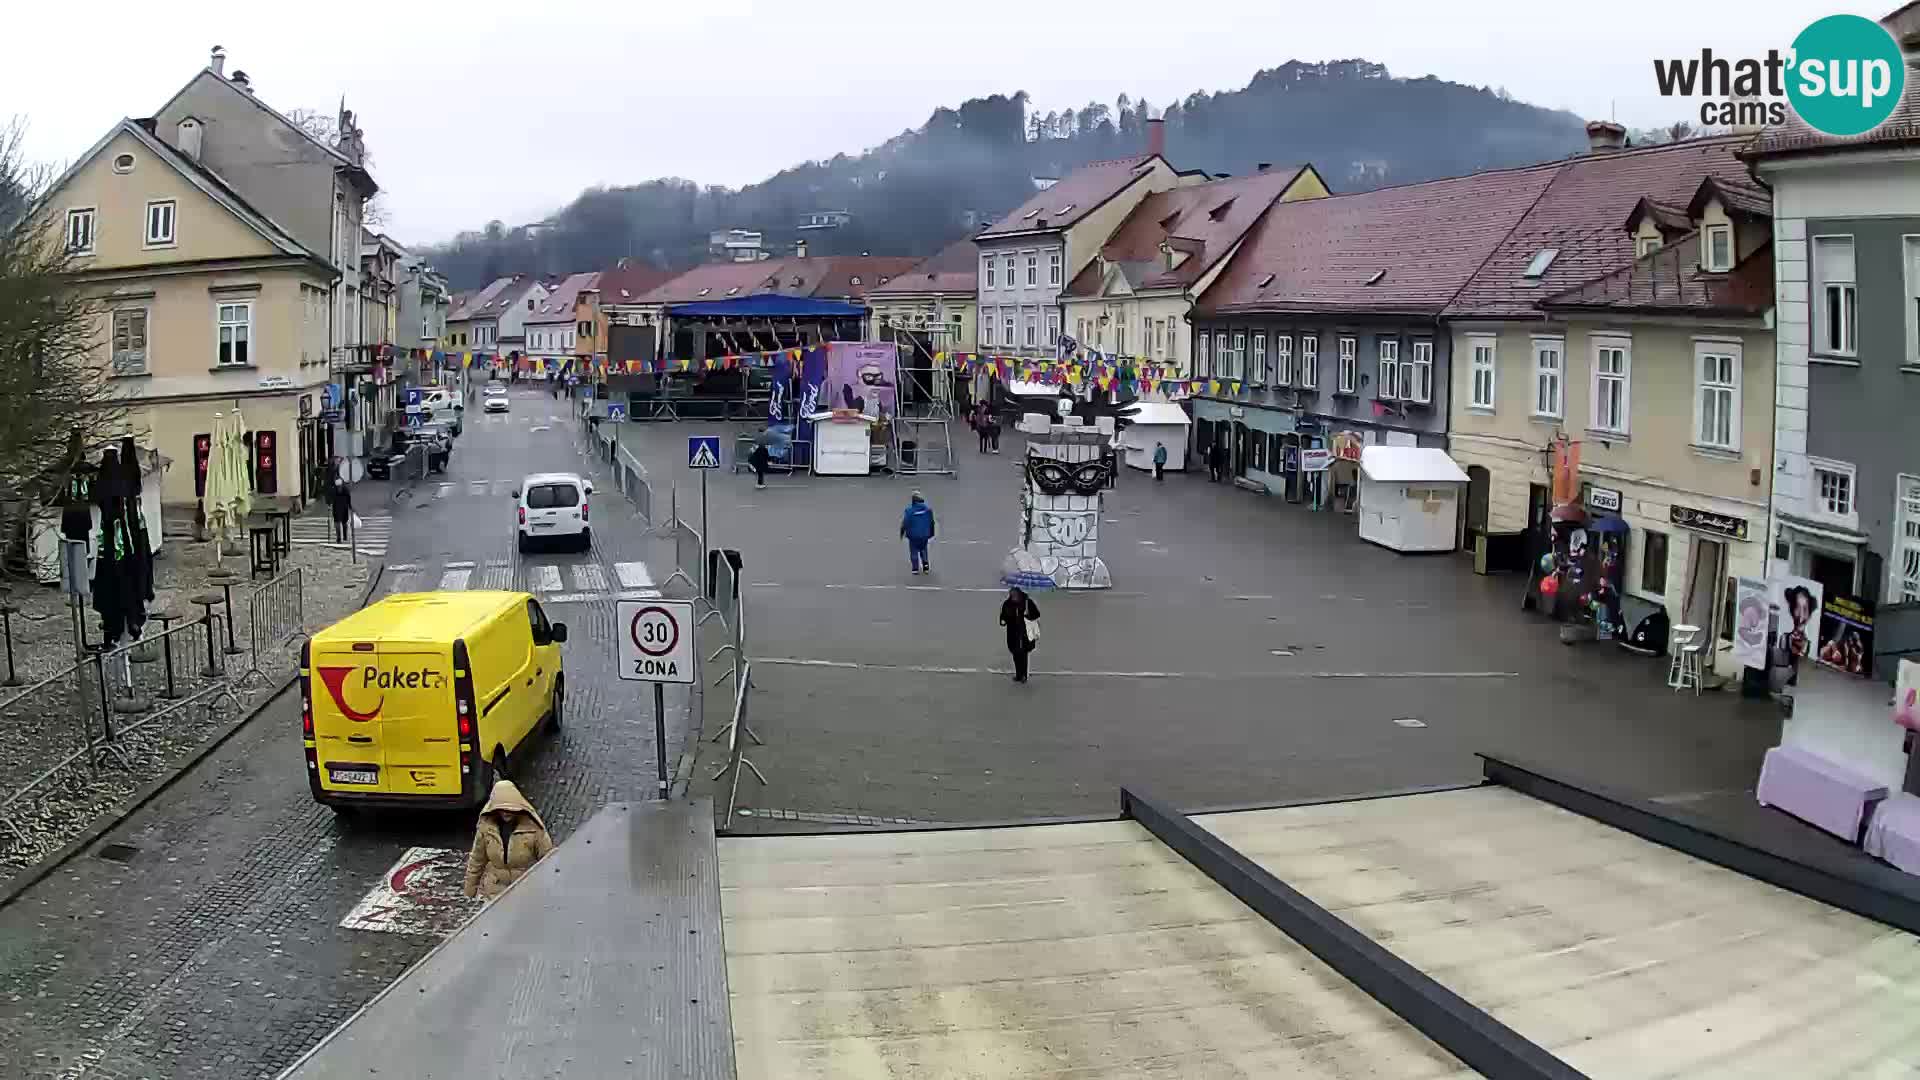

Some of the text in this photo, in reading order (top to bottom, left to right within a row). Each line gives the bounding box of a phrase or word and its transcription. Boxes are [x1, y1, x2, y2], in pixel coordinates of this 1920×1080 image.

[409, 391, 417, 404] P
[799, 382, 819, 419] Ford
[643, 622, 668, 643] 30
[633, 659, 678, 677] ZONA
